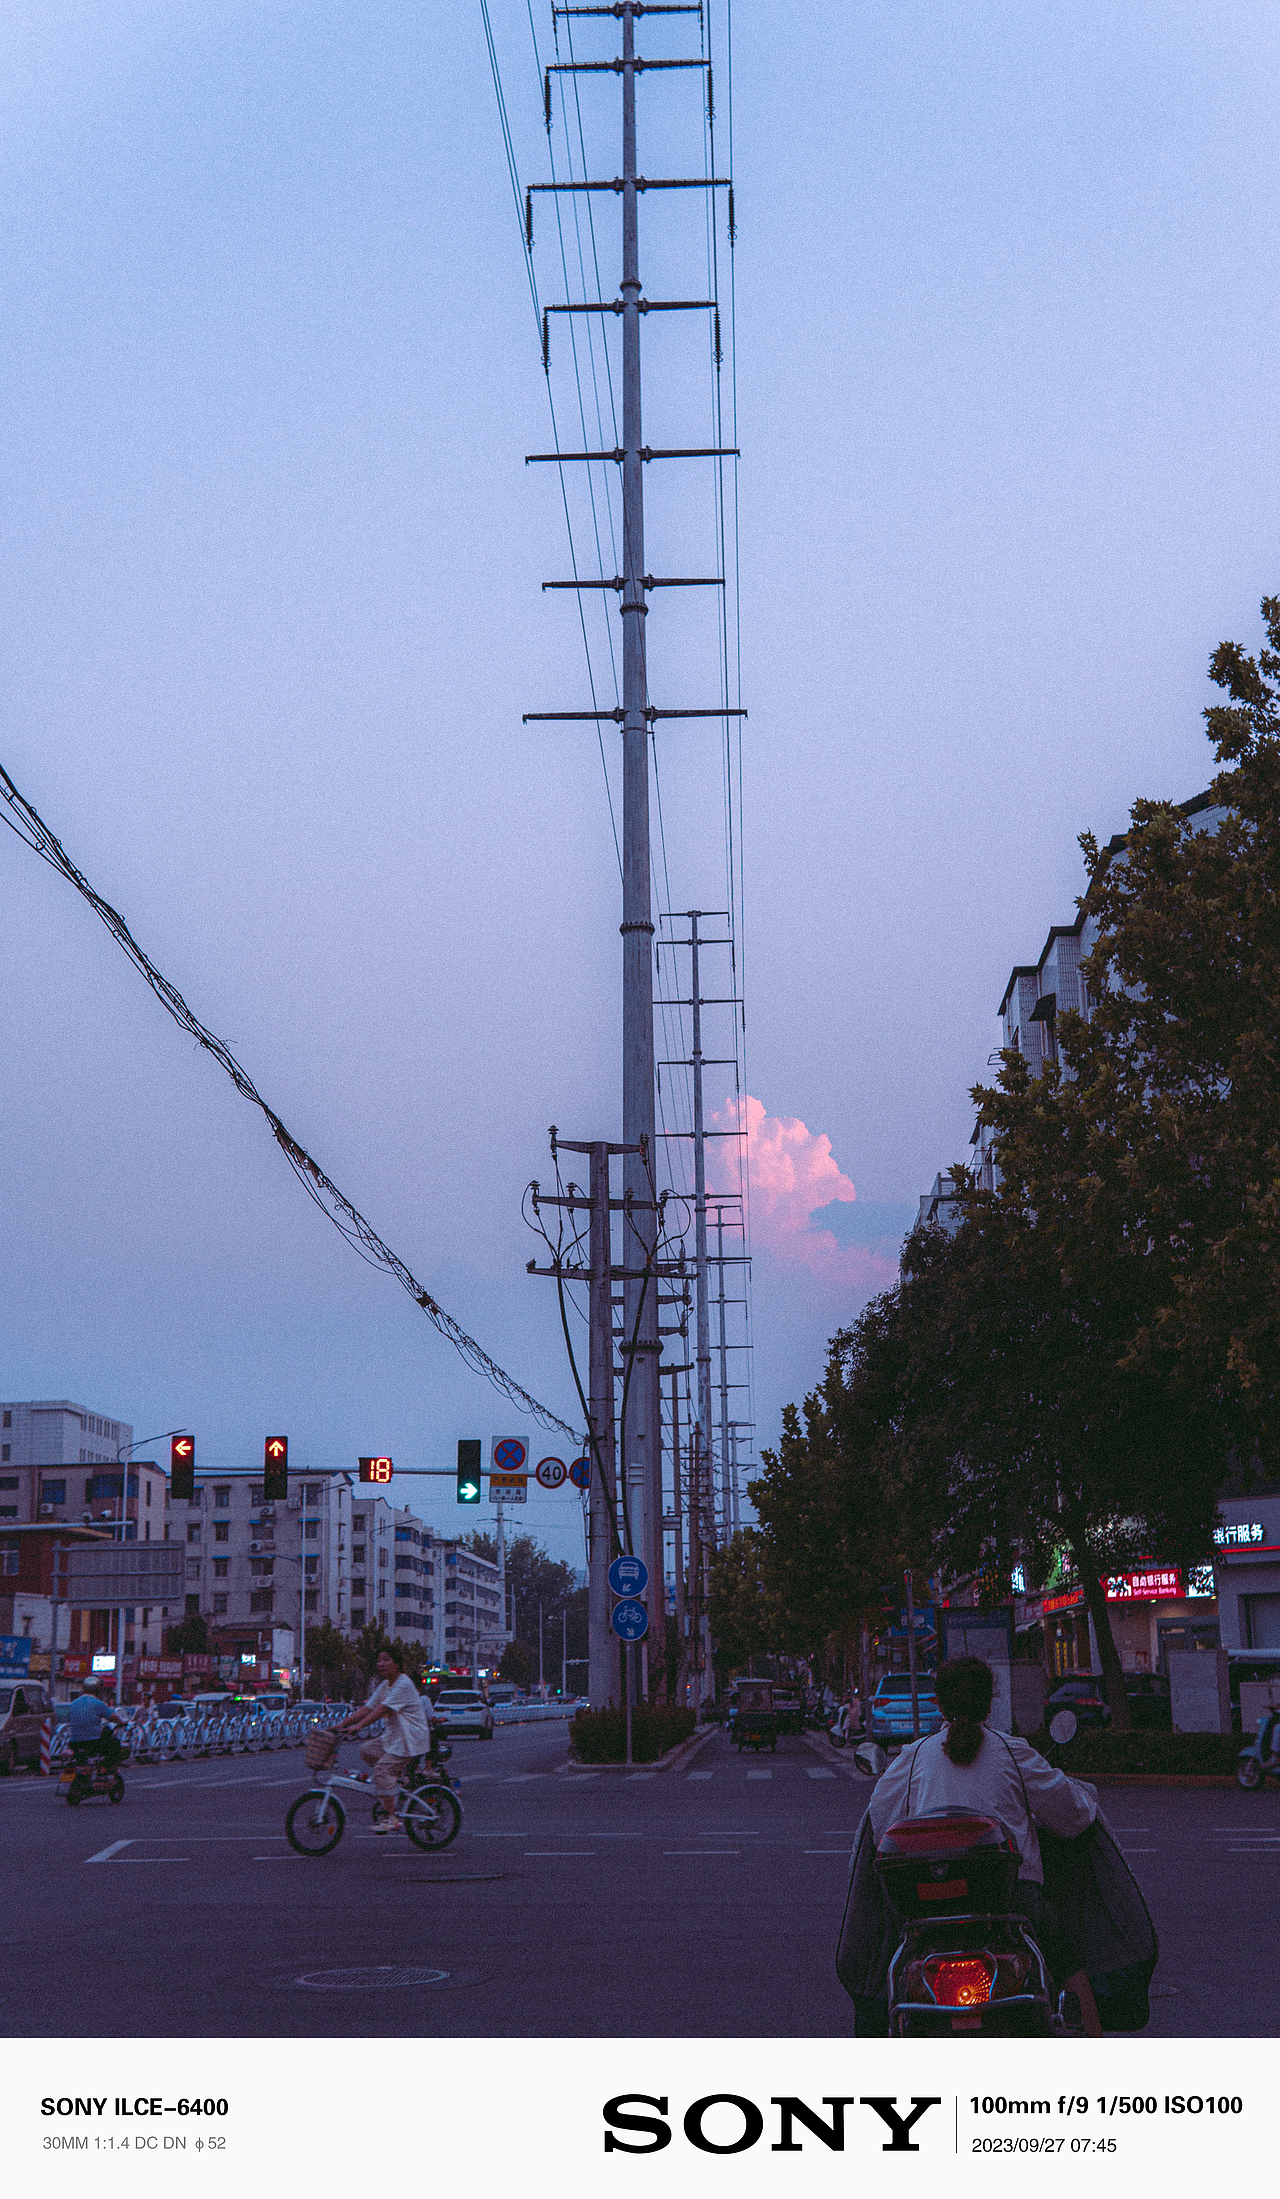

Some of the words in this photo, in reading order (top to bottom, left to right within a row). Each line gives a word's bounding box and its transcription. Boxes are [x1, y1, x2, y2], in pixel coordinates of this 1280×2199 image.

[370, 1458, 390, 1482] 18
[541, 1465, 561, 1481] 40
[1132, 1573, 1176, 1588] 自助银行服务
[1158, 1587, 1177, 1596] Banking
